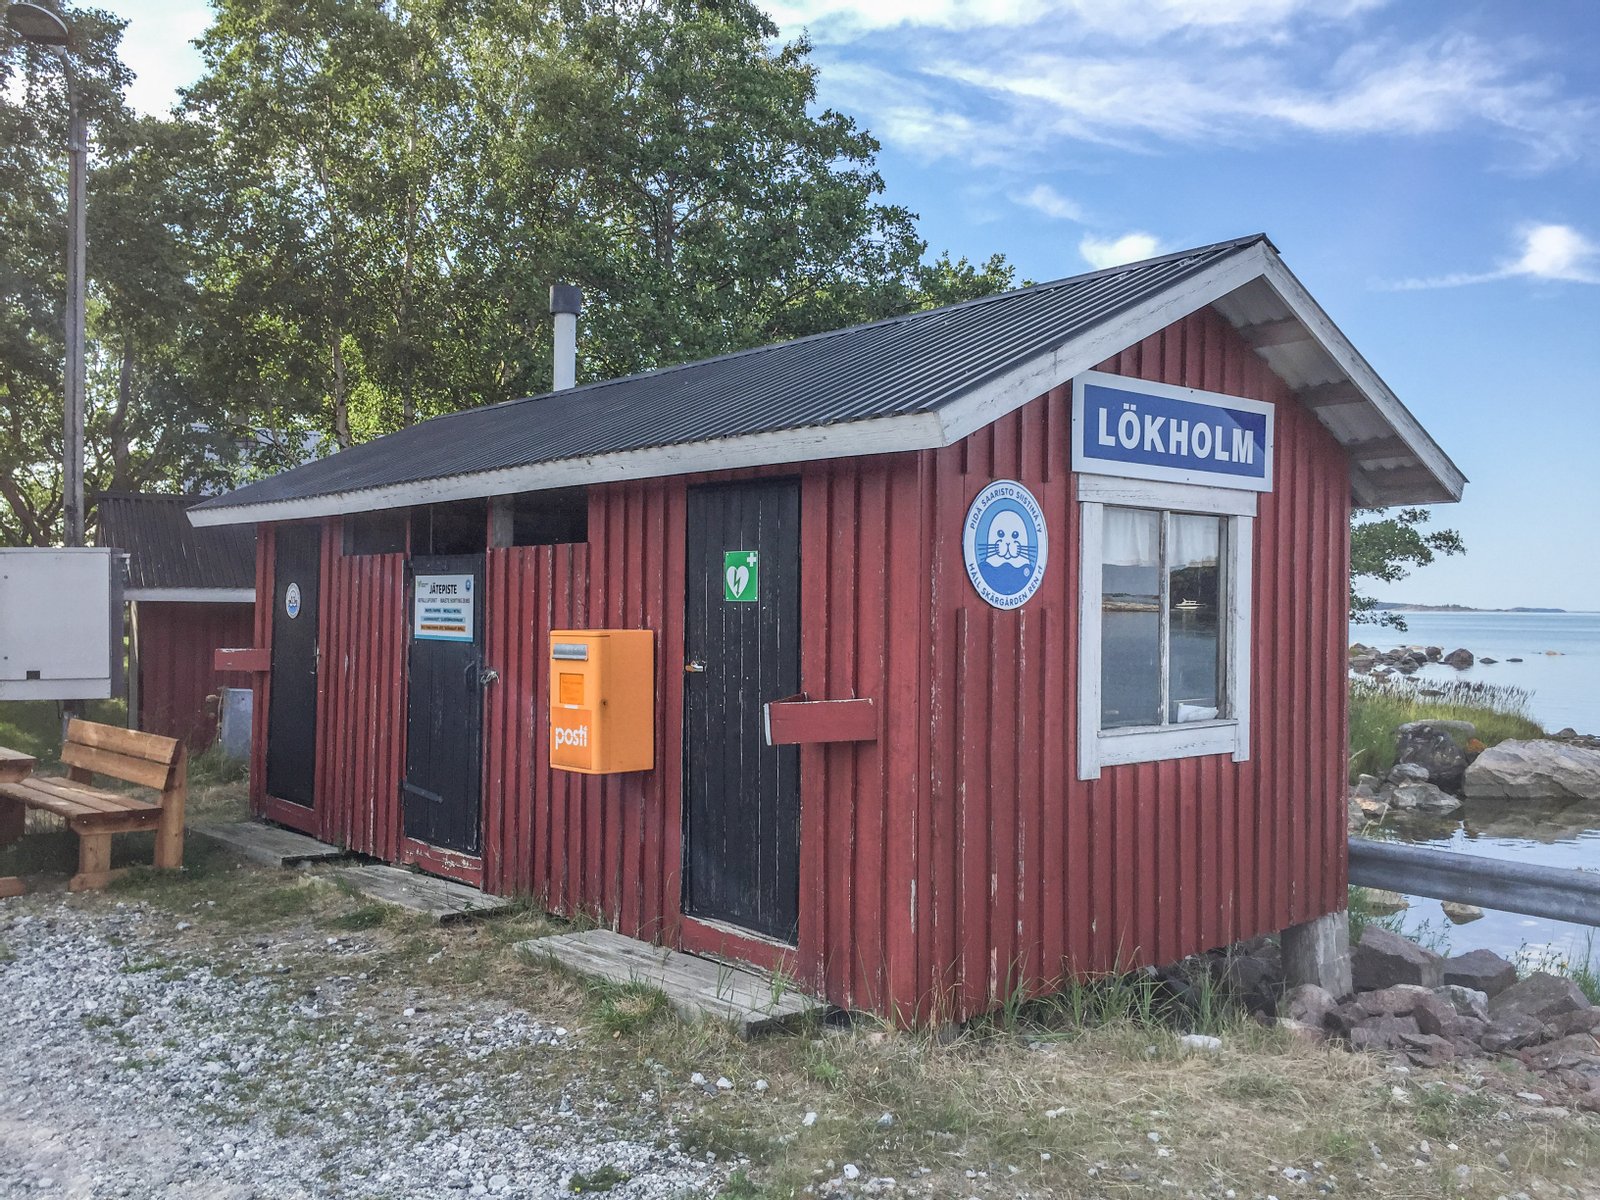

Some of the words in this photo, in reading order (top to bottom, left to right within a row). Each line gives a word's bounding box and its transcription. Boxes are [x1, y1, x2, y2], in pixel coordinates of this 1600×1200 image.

[1098, 402, 1254, 465] LÖKHOLM
[970, 506, 983, 530] PIDÄ
[981, 487, 1014, 507] SAARISTO
[1016, 491, 1039, 521] SIISTINÄ
[429, 582, 458, 595] JÄTEPISTE
[968, 563, 981, 589] HÅLL
[980, 587, 1028, 607] SKÄRGÅRDEN
[1027, 577, 1039, 594] REN
[555, 724, 588, 750] posti
